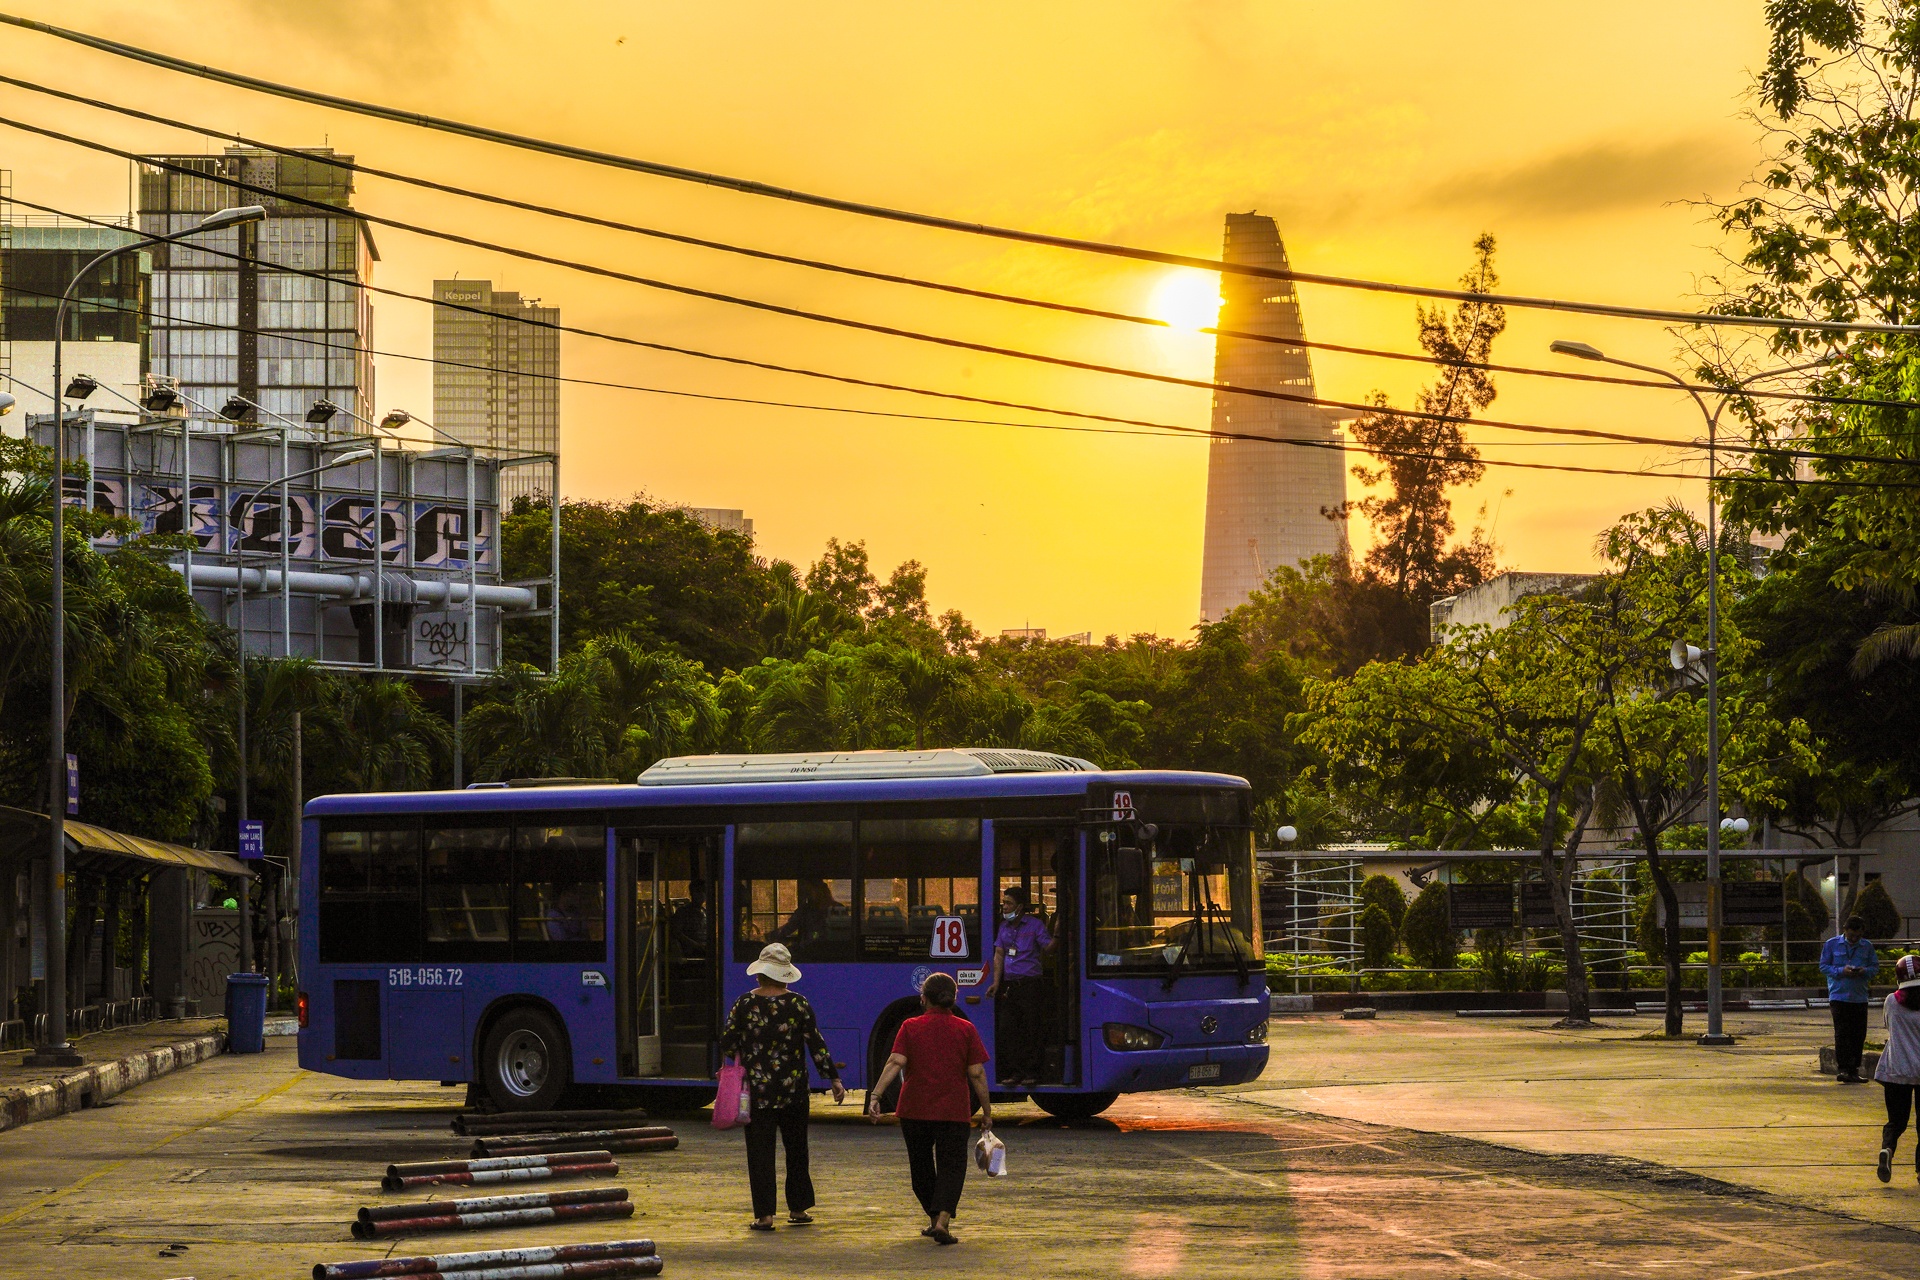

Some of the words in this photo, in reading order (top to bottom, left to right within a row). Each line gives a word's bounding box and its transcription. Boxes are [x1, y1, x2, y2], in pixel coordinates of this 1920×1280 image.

[445, 291, 481, 302] Keppel
[936, 920, 962, 953] 18
[389, 968, 463, 986] 51B-056.72
